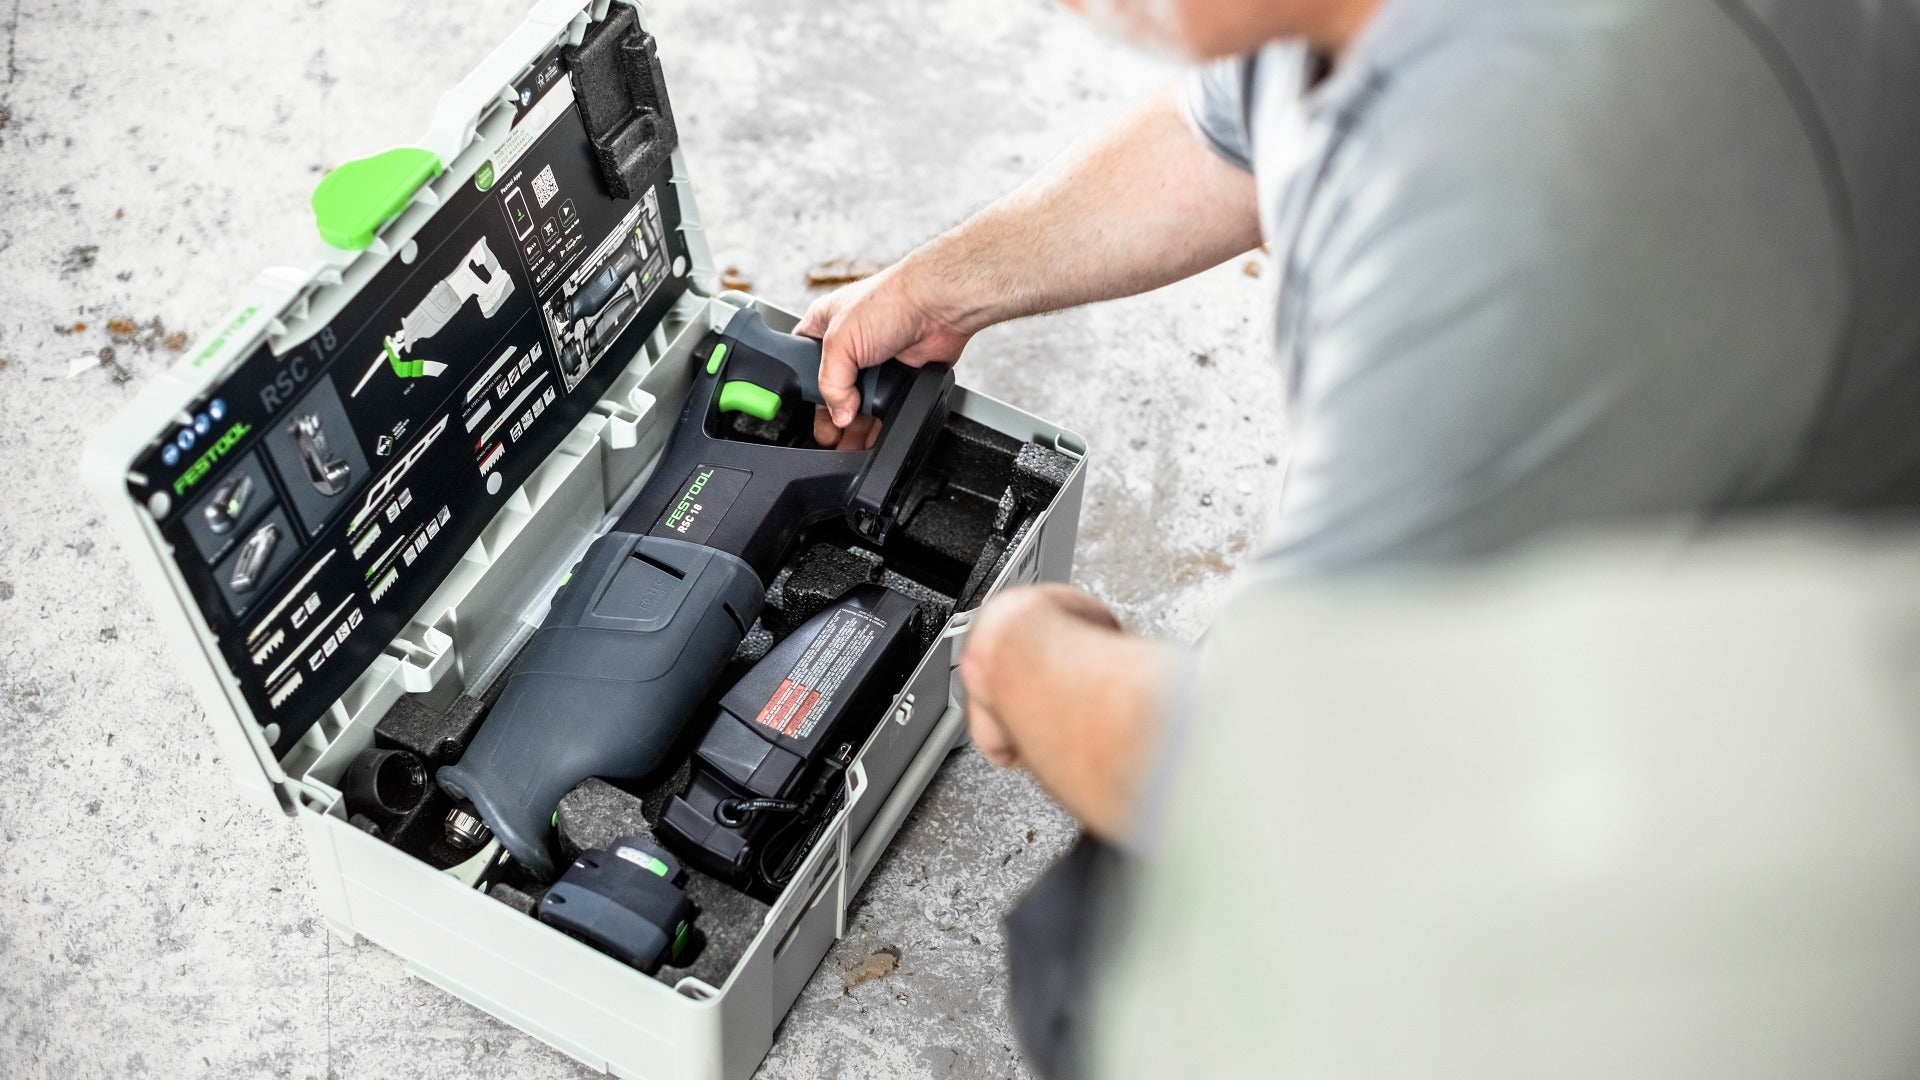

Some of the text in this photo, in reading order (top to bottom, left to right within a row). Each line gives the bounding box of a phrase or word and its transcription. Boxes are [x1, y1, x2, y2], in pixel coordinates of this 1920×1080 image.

[259, 326, 338, 413] RSC 18
[173, 422, 251, 496] FESTOOL
[665, 470, 714, 528] FESTOOL
[677, 503, 703, 534] RSC 18
